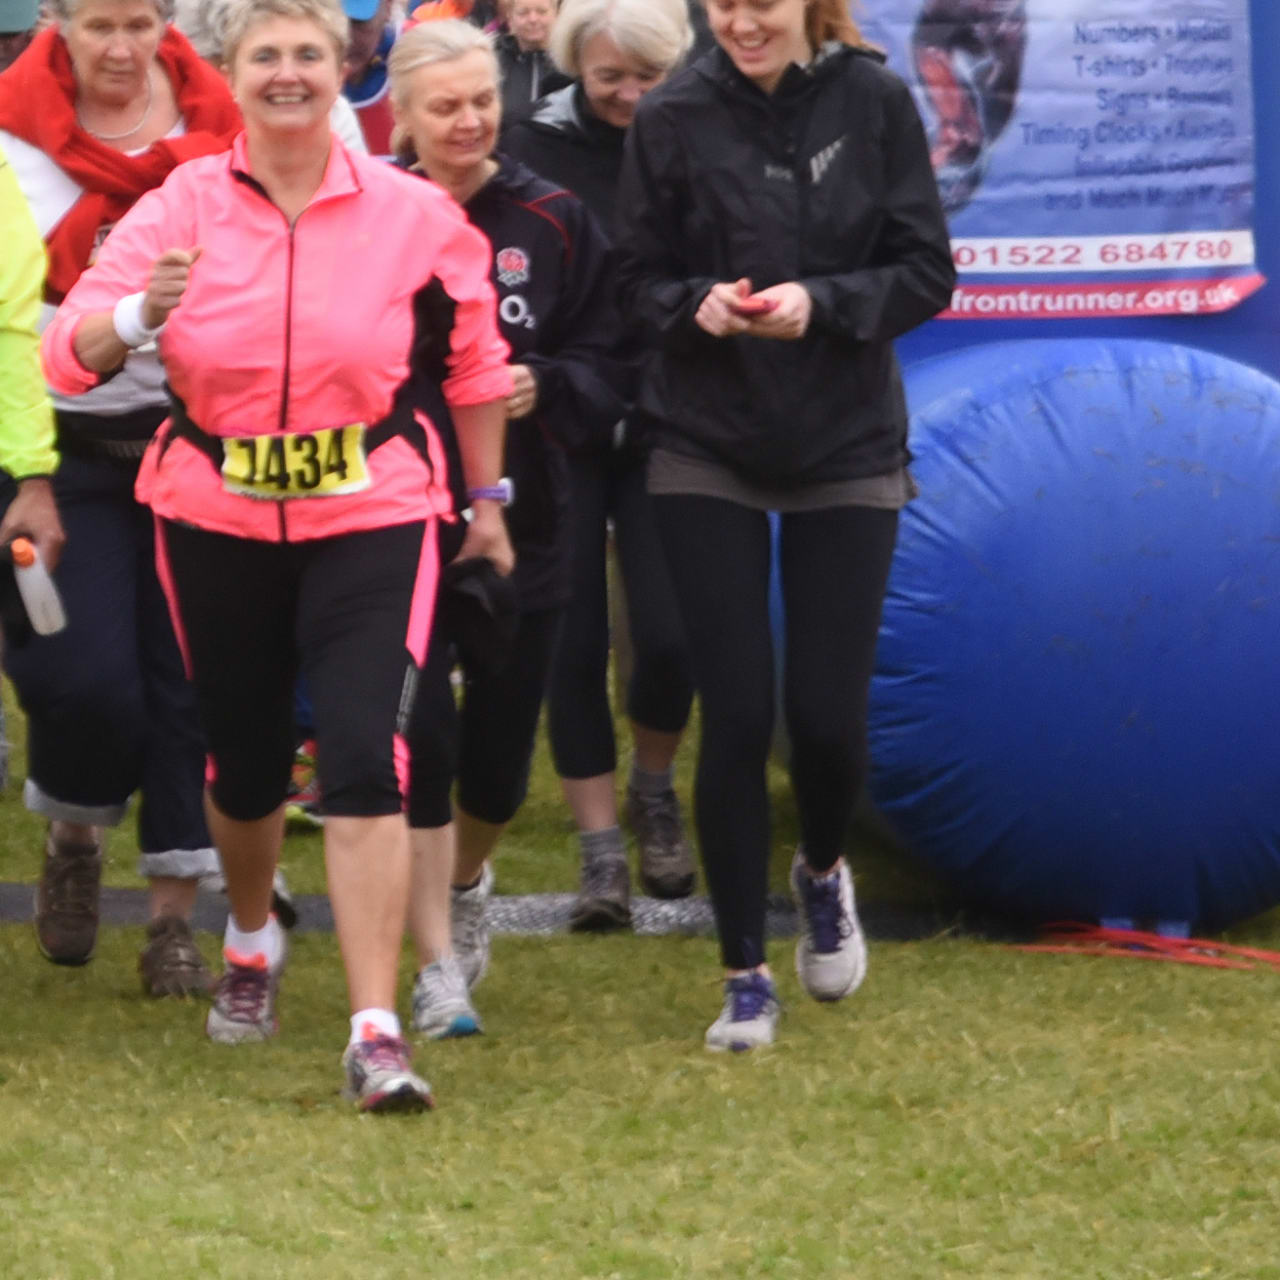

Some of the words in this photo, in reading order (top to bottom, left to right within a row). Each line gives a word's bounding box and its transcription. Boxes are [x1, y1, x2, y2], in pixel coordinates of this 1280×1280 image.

[955, 245, 1081, 266] 01522
[1099, 239, 1232, 263] 684780
[951, 282, 1236, 313] frontrunner.org.uk
